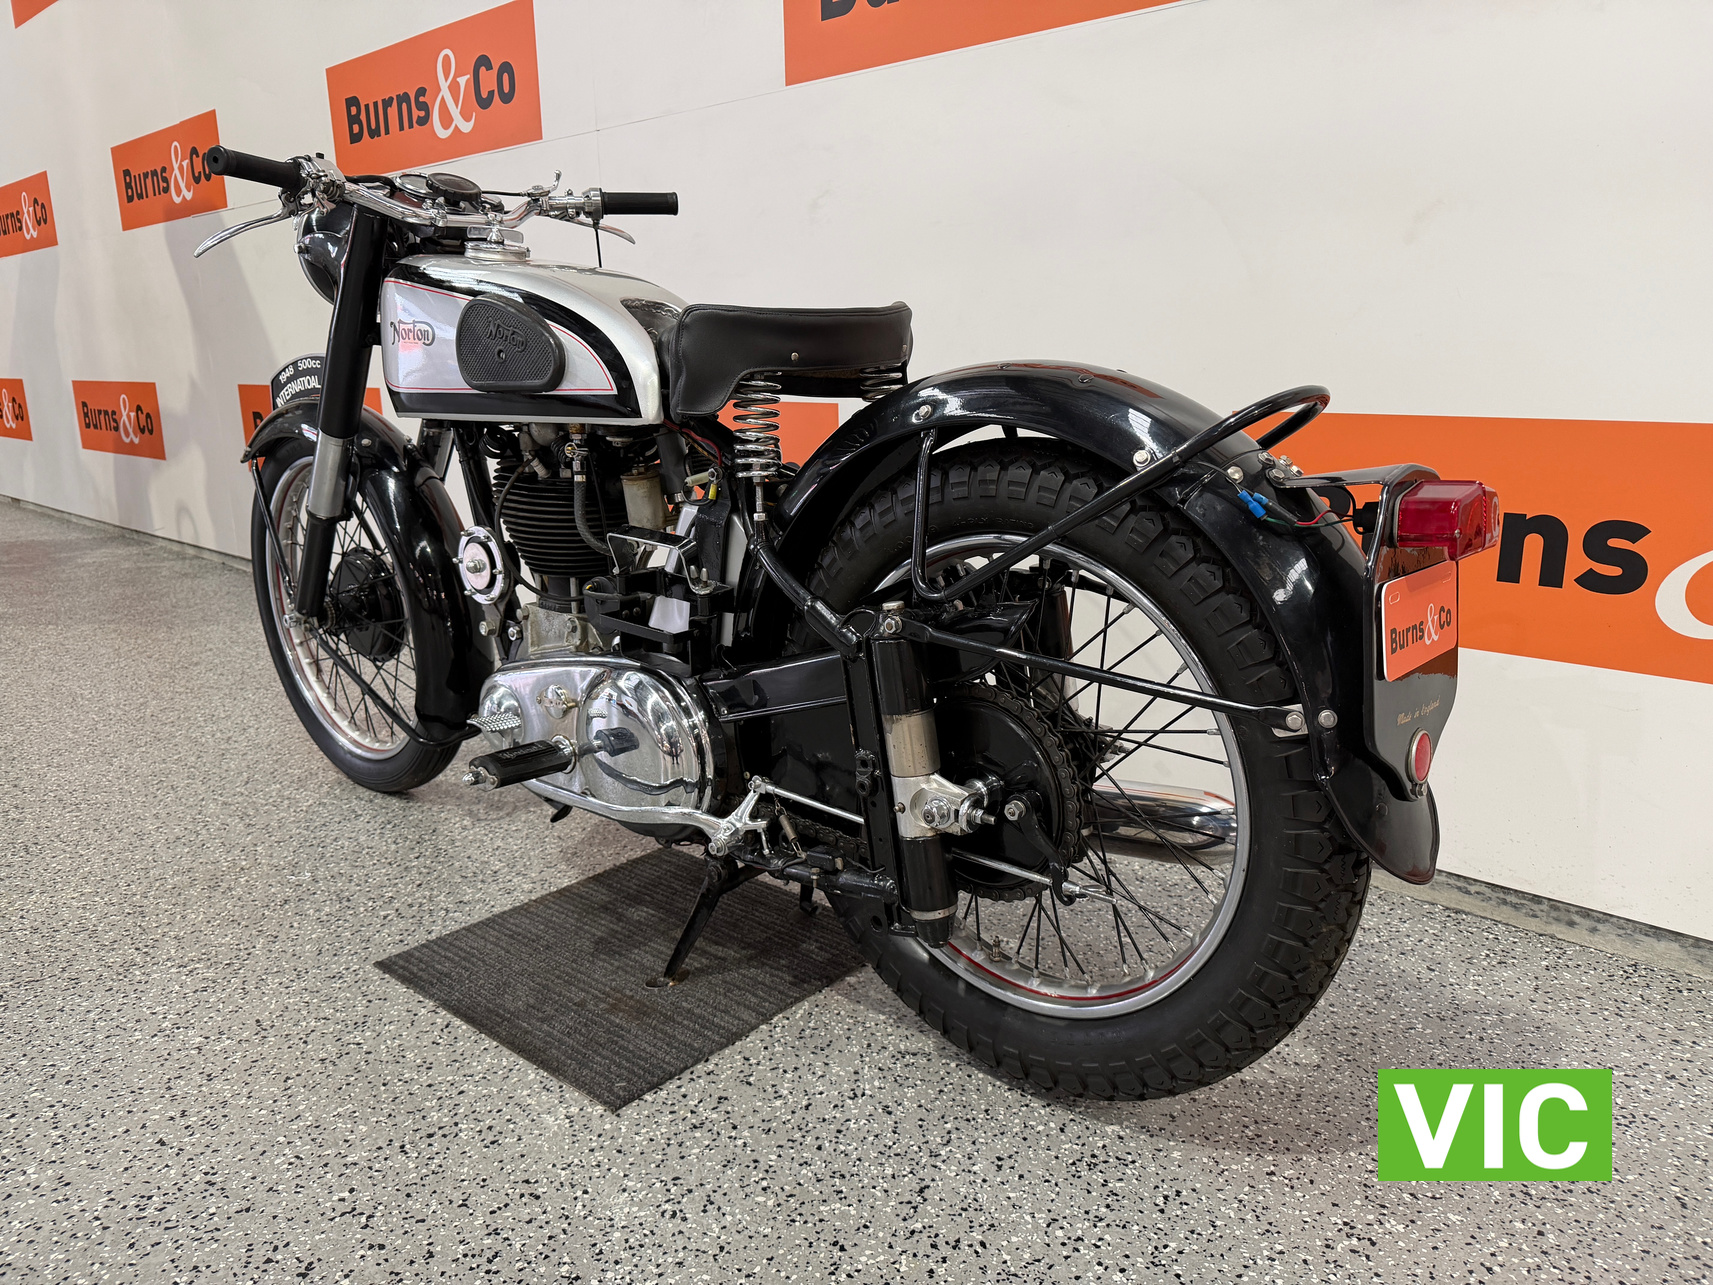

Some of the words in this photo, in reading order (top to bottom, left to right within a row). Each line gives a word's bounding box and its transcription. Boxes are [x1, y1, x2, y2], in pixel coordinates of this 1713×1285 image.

[345, 48, 516, 144] Burns&Co
[0, 191, 48, 240] urns&Co
[390, 318, 436, 347] Norton
[487, 315, 528, 353] Norton
[297, 358, 321, 371] 500cc
[275, 375, 322, 408] INTERNATIOAL
[81, 394, 154, 444] Burns&Co
[1390, 603, 1452, 655] Burns&Co
[1396, 712, 1412, 726] Made
[1413, 707, 1420, 719] in
